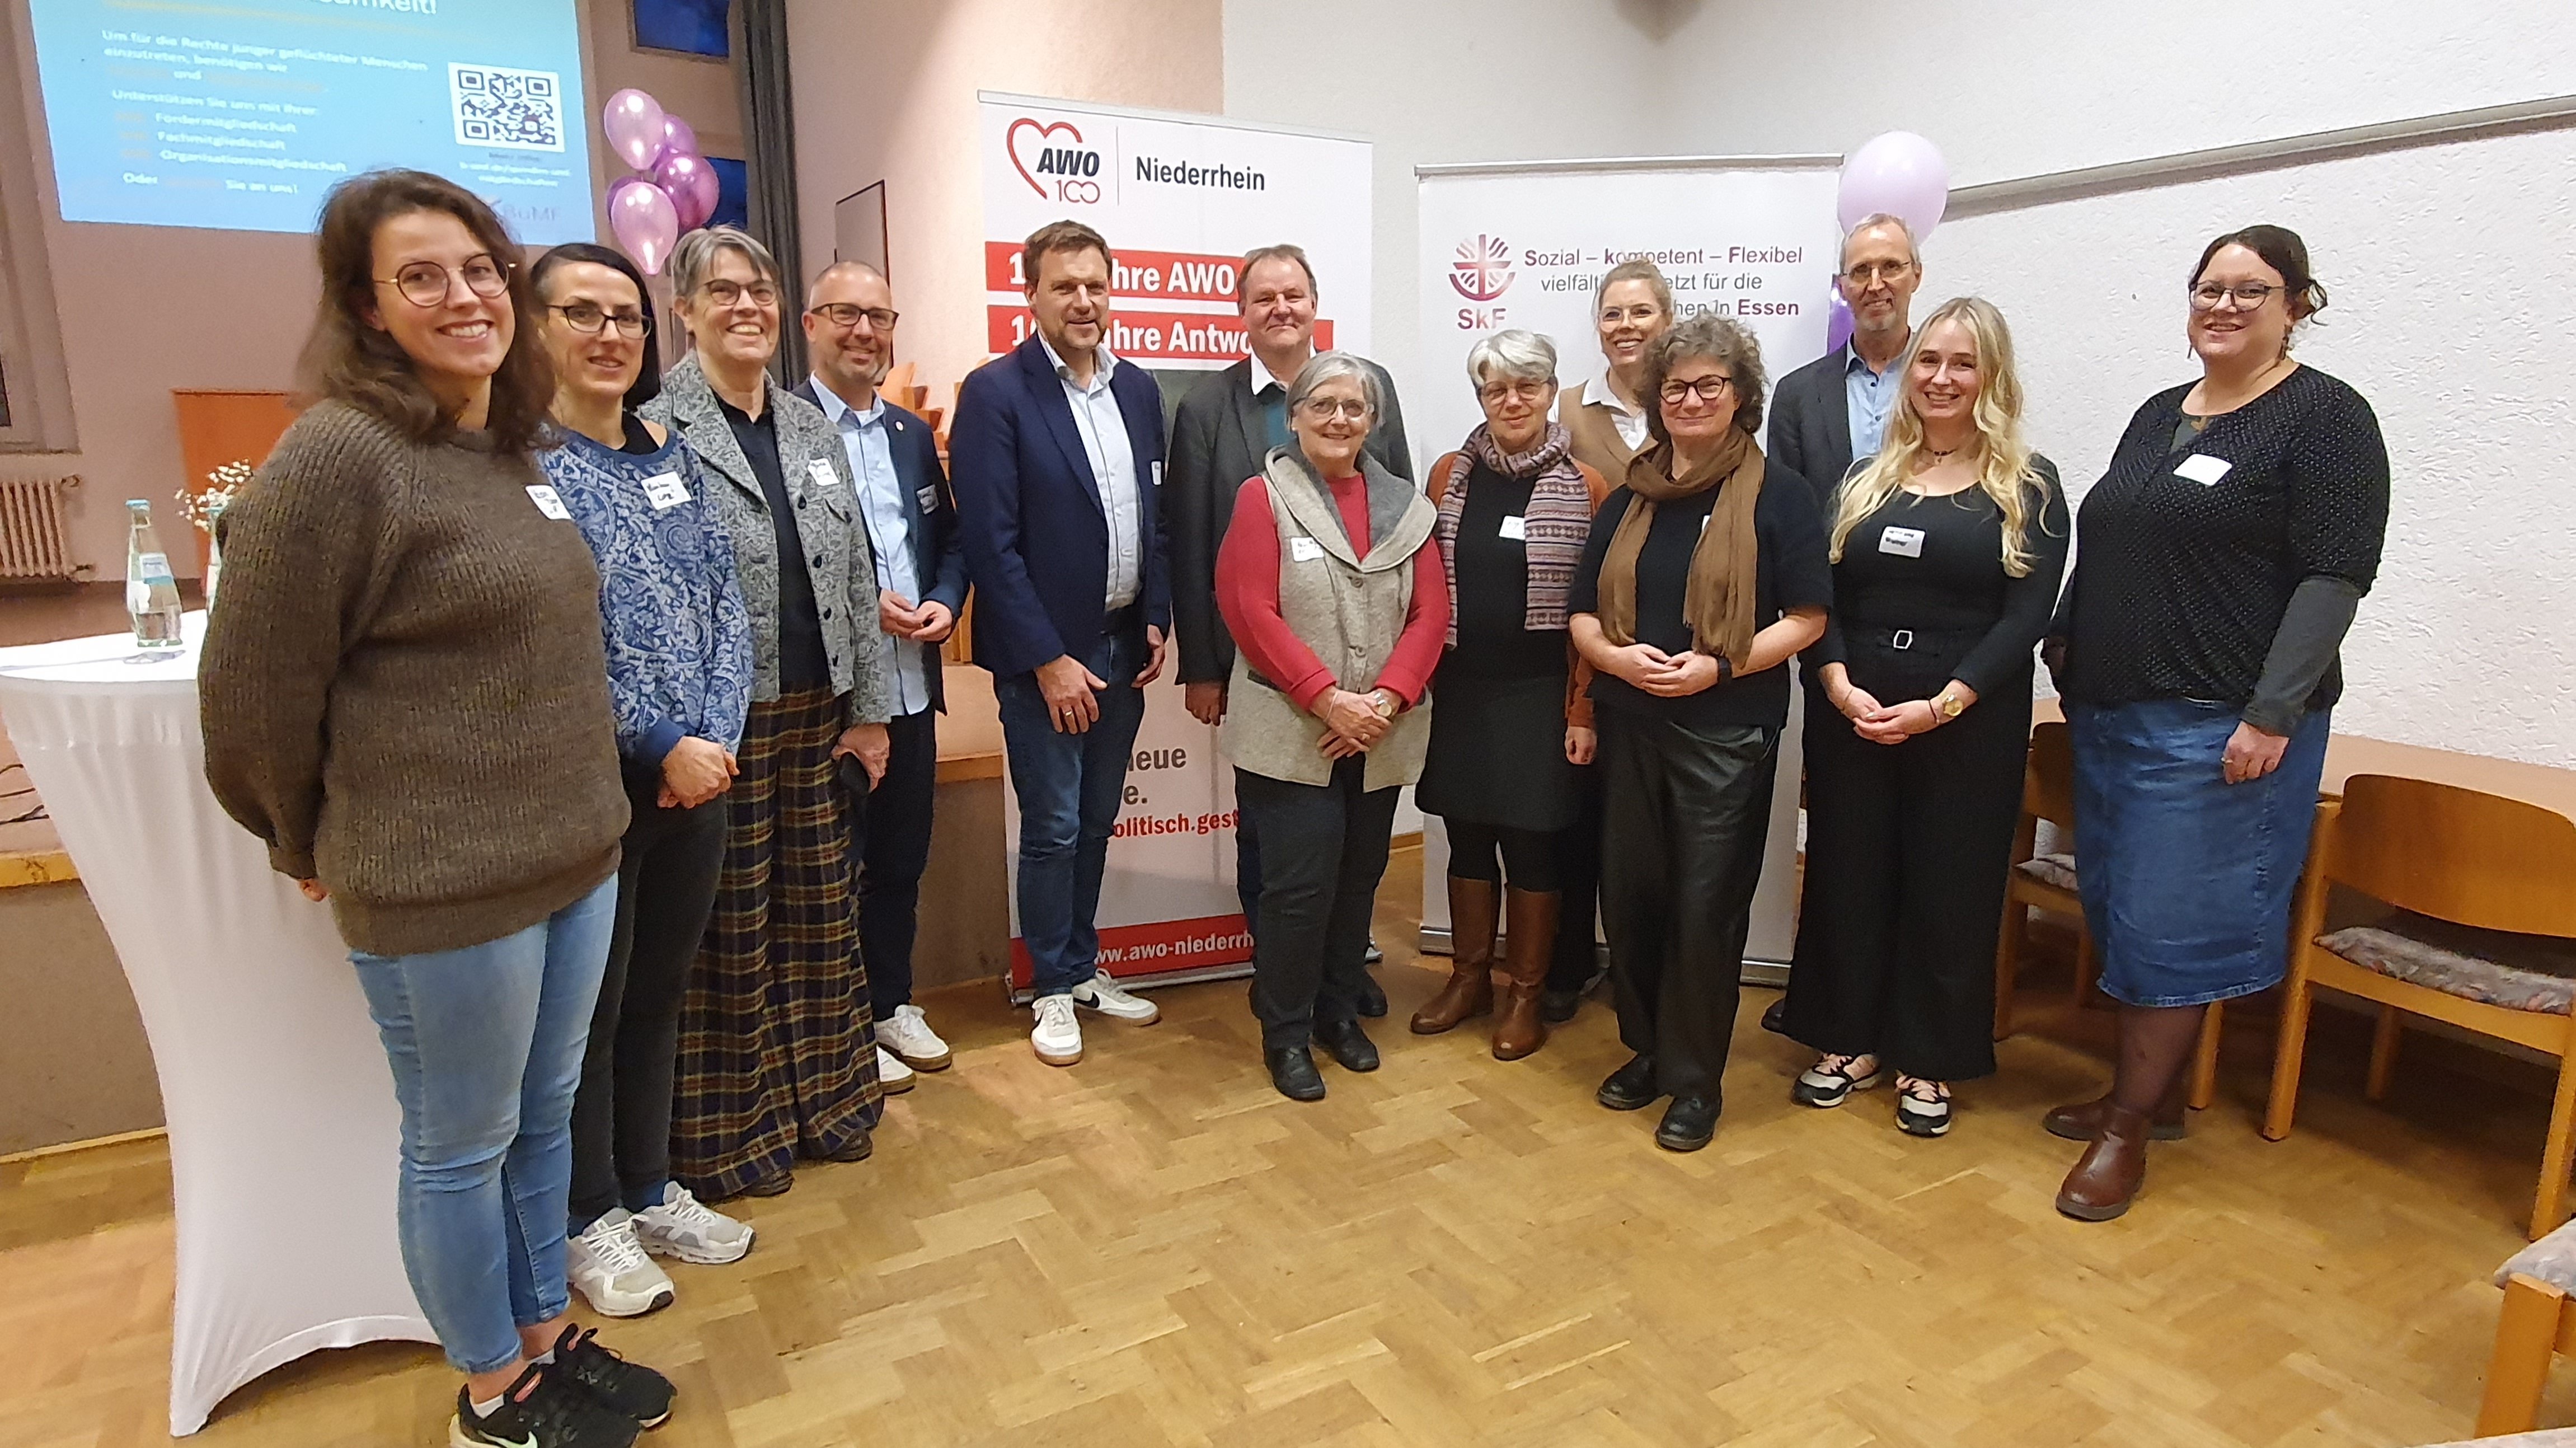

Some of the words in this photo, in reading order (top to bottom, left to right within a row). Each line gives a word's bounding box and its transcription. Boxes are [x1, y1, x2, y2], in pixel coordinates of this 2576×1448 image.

[102, 30, 127, 41] Um
[130, 31, 151, 43] für
[156, 35, 177, 46] die
[181, 37, 229, 51] Rechte
[232, 44, 276, 57] junger
[279, 49, 358, 64] geflüchteter
[361, 56, 429, 71] Menschen
[194, 55, 264, 70] benötigen
[173, 70, 202, 81] und
[112, 89, 204, 105] Unterstützen
[206, 97, 227, 108] Sie
[231, 101, 256, 111] uns
[259, 102, 281, 113] mit
[156, 112, 297, 134] Fördermitgliedschaft
[157, 131, 286, 151] Fachmitgliedschaft
[159, 149, 348, 172] Organisationsmitgliedschaft
[1036, 148, 1100, 177] AWO
[1135, 156, 1265, 191] Niederrhein
[123, 172, 158, 185] Oder
[226, 179, 246, 191] Sie
[1055, 180, 1101, 204] 100
[1525, 249, 1579, 266] Sozial
[1729, 246, 1802, 263] Flexibel
[1112, 257, 1160, 292] hre
[1167, 261, 1235, 296] AWO
[1704, 273, 1728, 289] für
[1734, 273, 1762, 289] die
[1738, 299, 1799, 315] Essen
[1458, 308, 1506, 329] SkF
[1167, 321, 1251, 354] Antwo
[1113, 809, 1240, 837] olitisch.gest
